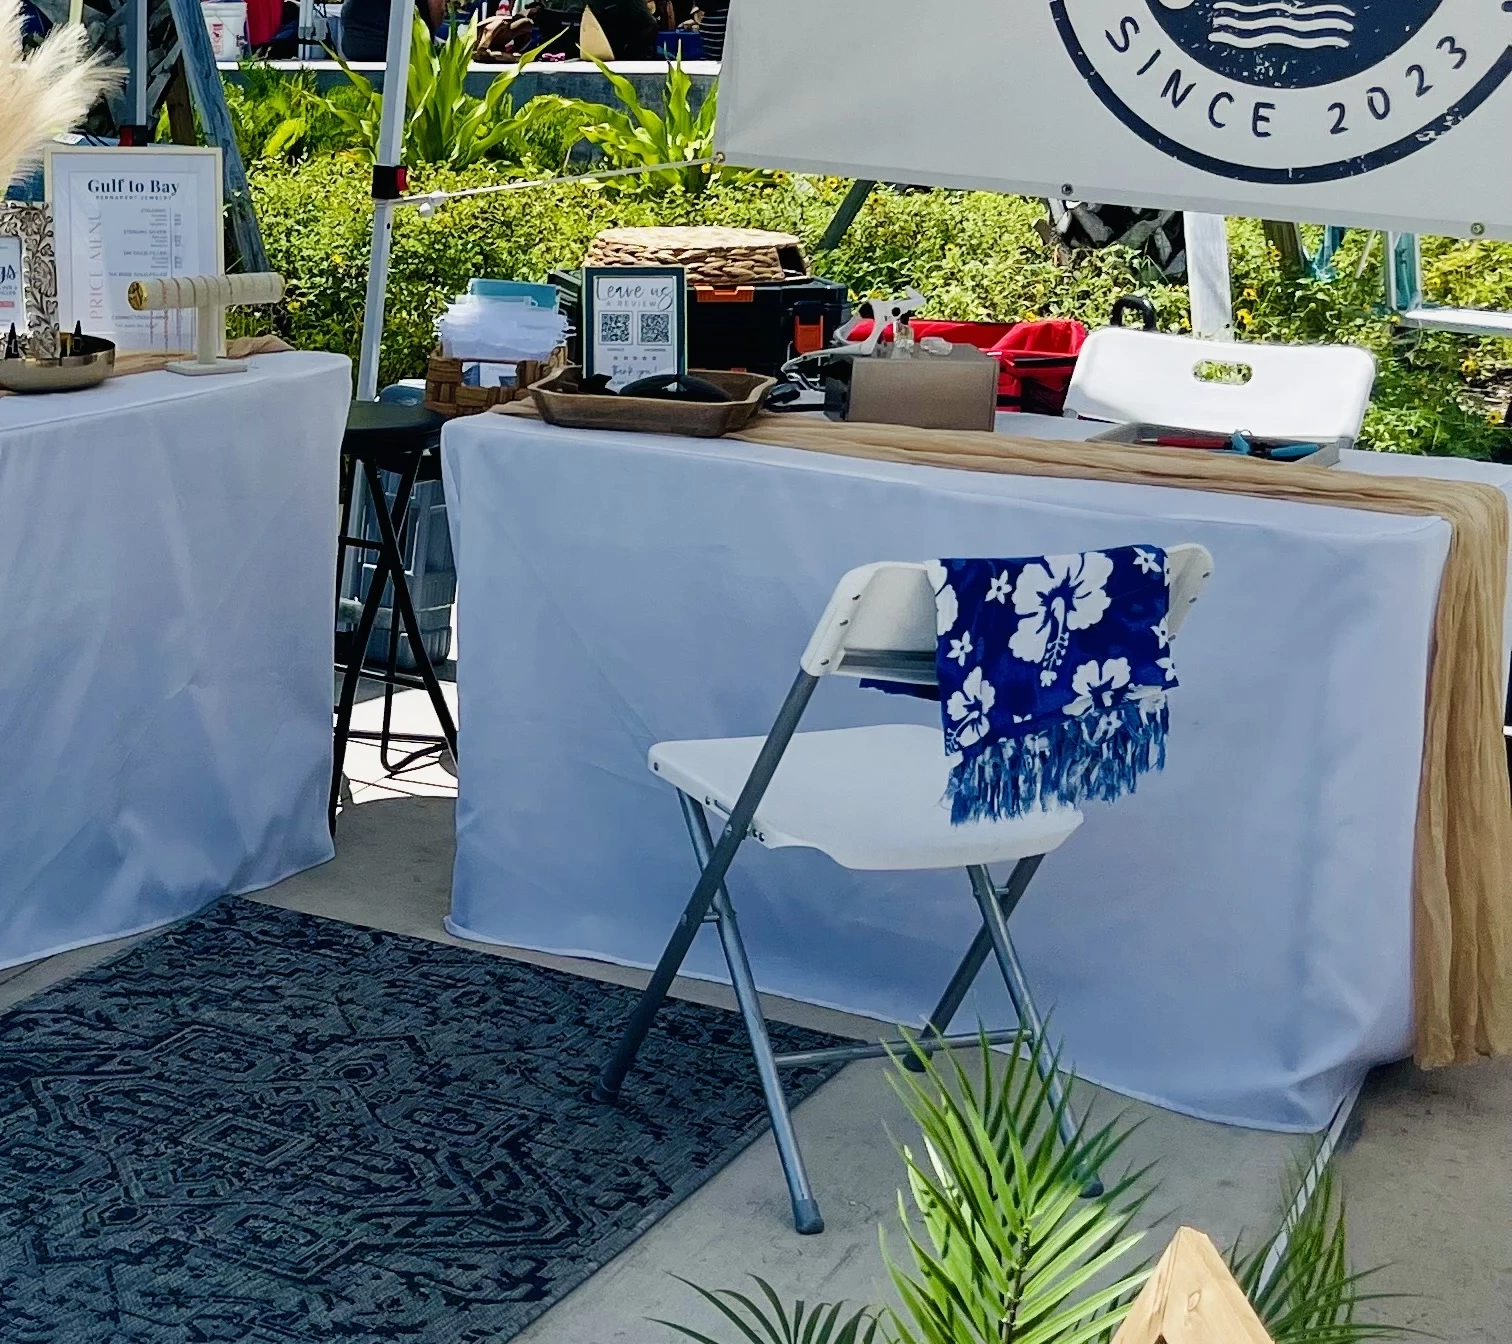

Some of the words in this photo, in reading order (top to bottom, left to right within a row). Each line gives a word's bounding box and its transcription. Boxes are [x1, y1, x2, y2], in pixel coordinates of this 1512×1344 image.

[1105, 15, 1276, 138] SINCE
[1327, 36, 1467, 136] 2023
[88, 179, 124, 193] Gulf
[129, 180, 144, 193] to
[150, 180, 179, 196] Bay
[597, 279, 644, 300] Leave
[650, 287, 673, 311] us
